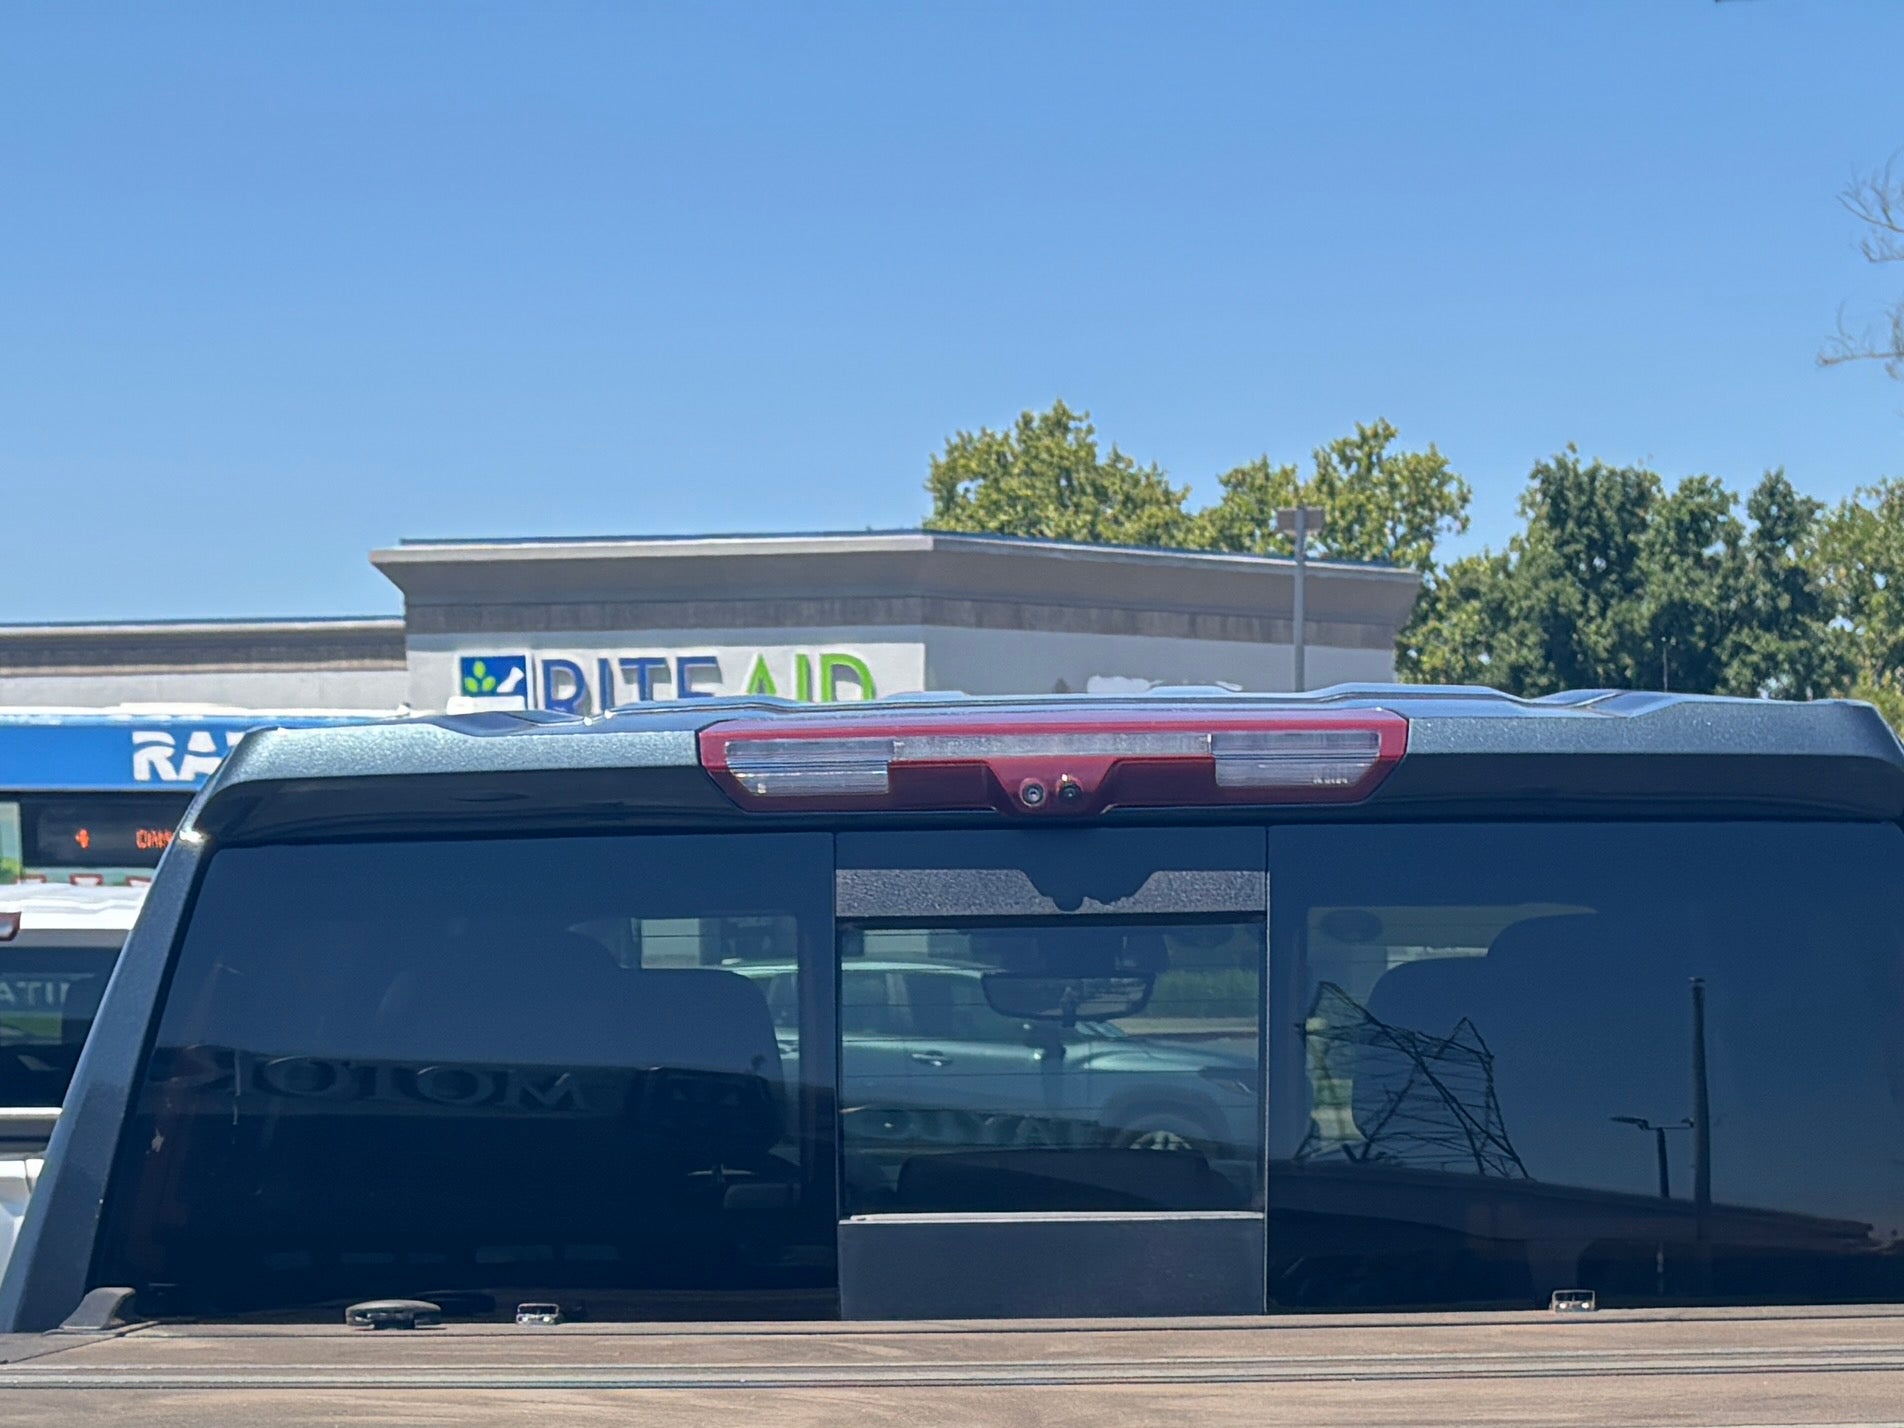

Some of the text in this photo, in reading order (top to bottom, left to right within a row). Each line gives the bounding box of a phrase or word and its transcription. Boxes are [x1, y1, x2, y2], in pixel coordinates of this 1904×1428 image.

[542, 653, 876, 714] RITE AID
[132, 731, 245, 781] RA
